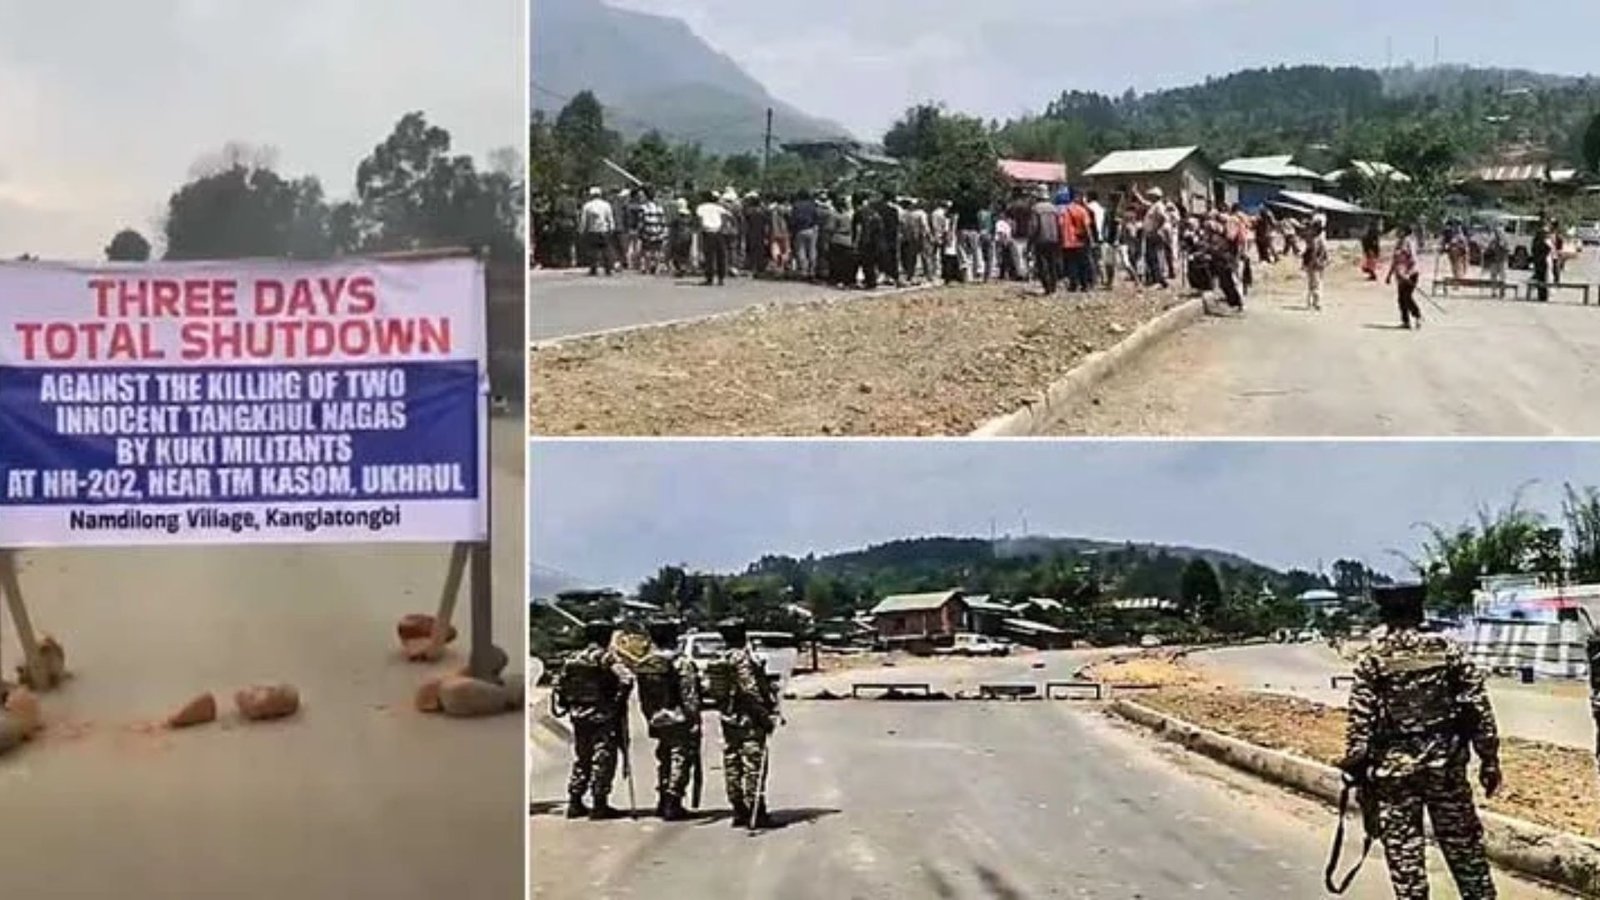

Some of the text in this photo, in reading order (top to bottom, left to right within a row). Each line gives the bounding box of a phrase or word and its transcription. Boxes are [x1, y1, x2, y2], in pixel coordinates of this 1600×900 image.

[88, 277, 377, 319] THREE DAYS
[15, 318, 452, 361] TOTAL SHUTDOWN
[40, 370, 406, 402] AGAINST THE KILLING OF TWO
[56, 401, 407, 434] INNOCENT TANGKHUL NAGAS
[116, 435, 352, 466] BY KUKI MILITANTS
[7, 464, 464, 501] AT NH-202, NEAR TM KASOM, UKHRUL
[70, 505, 401, 533] Namdilong Village, Kanglatongbi
